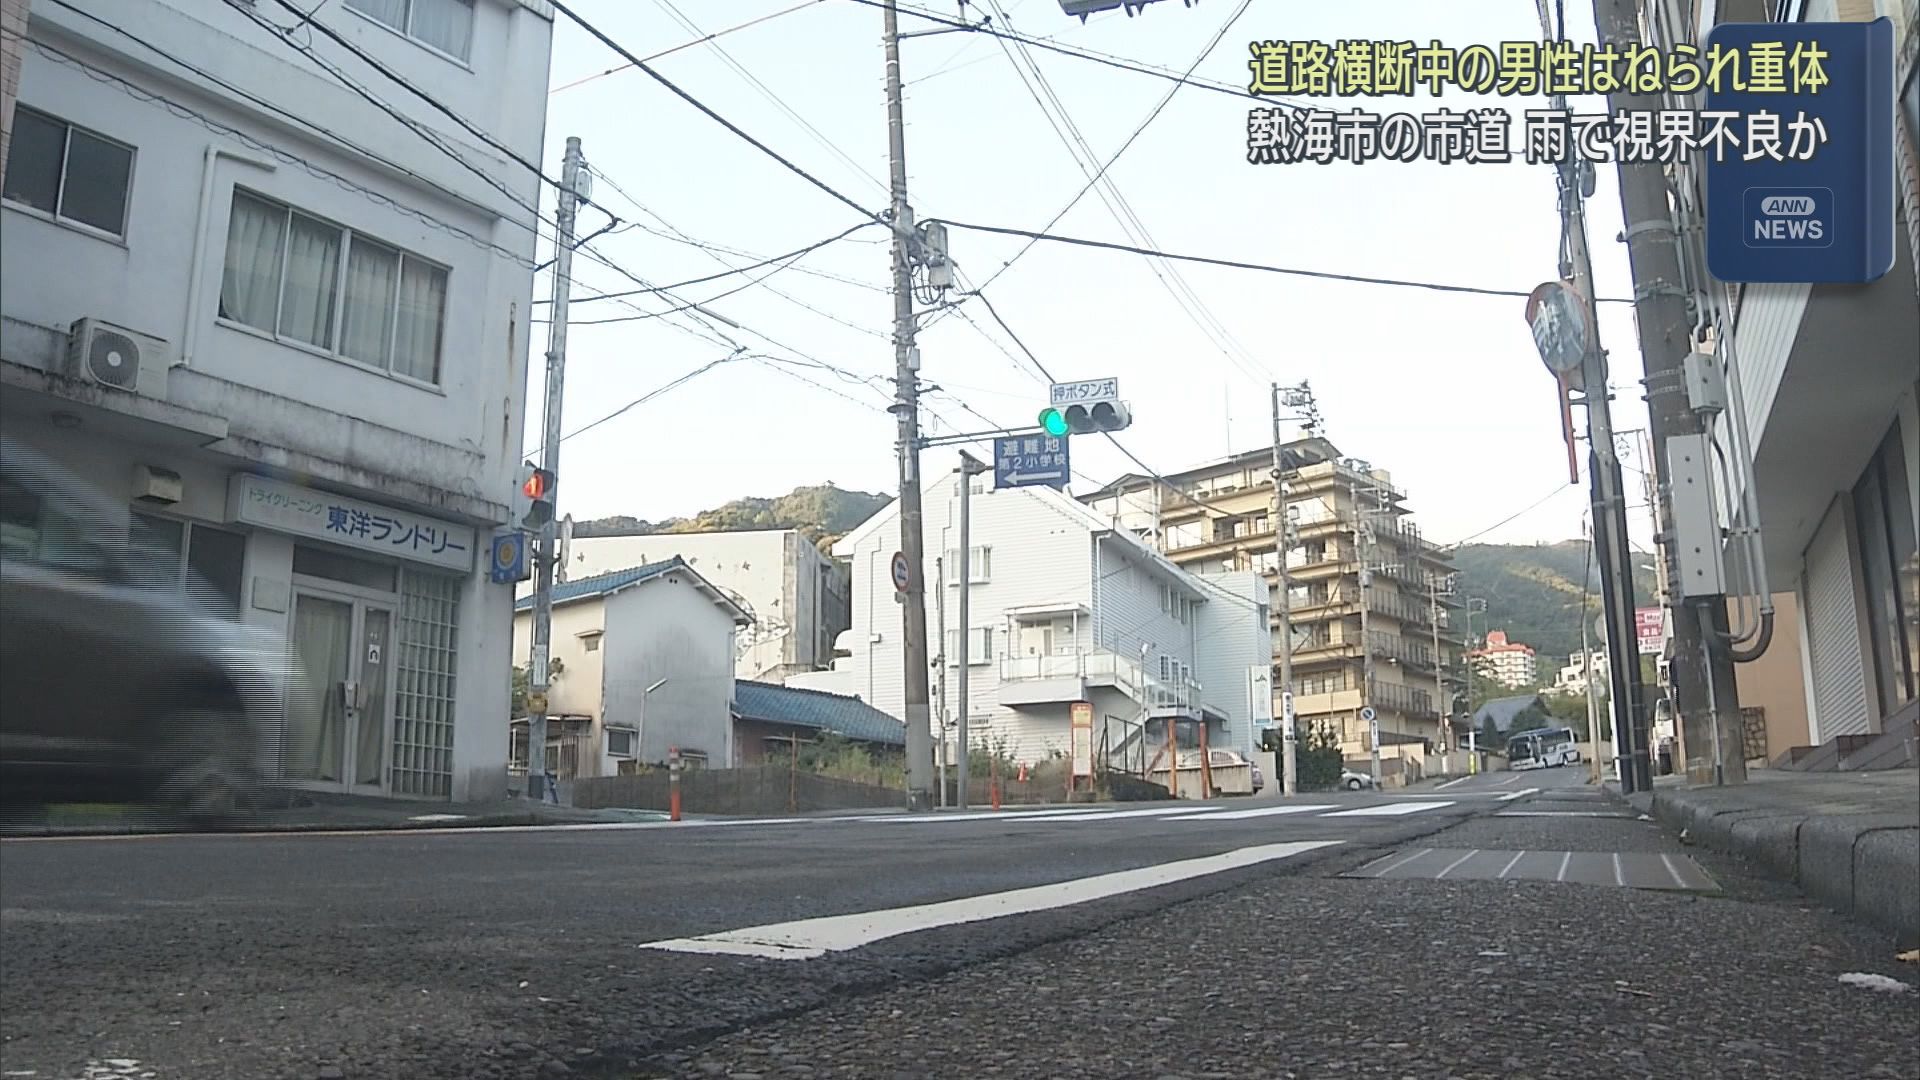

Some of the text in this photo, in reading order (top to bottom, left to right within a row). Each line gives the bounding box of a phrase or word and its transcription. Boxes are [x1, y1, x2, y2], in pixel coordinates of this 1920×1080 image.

[1054, 382, 1115, 401] 押ボタン式
[1002, 437, 1061, 457] 避難地
[326, 505, 466, 553] 東洋ランドリー
